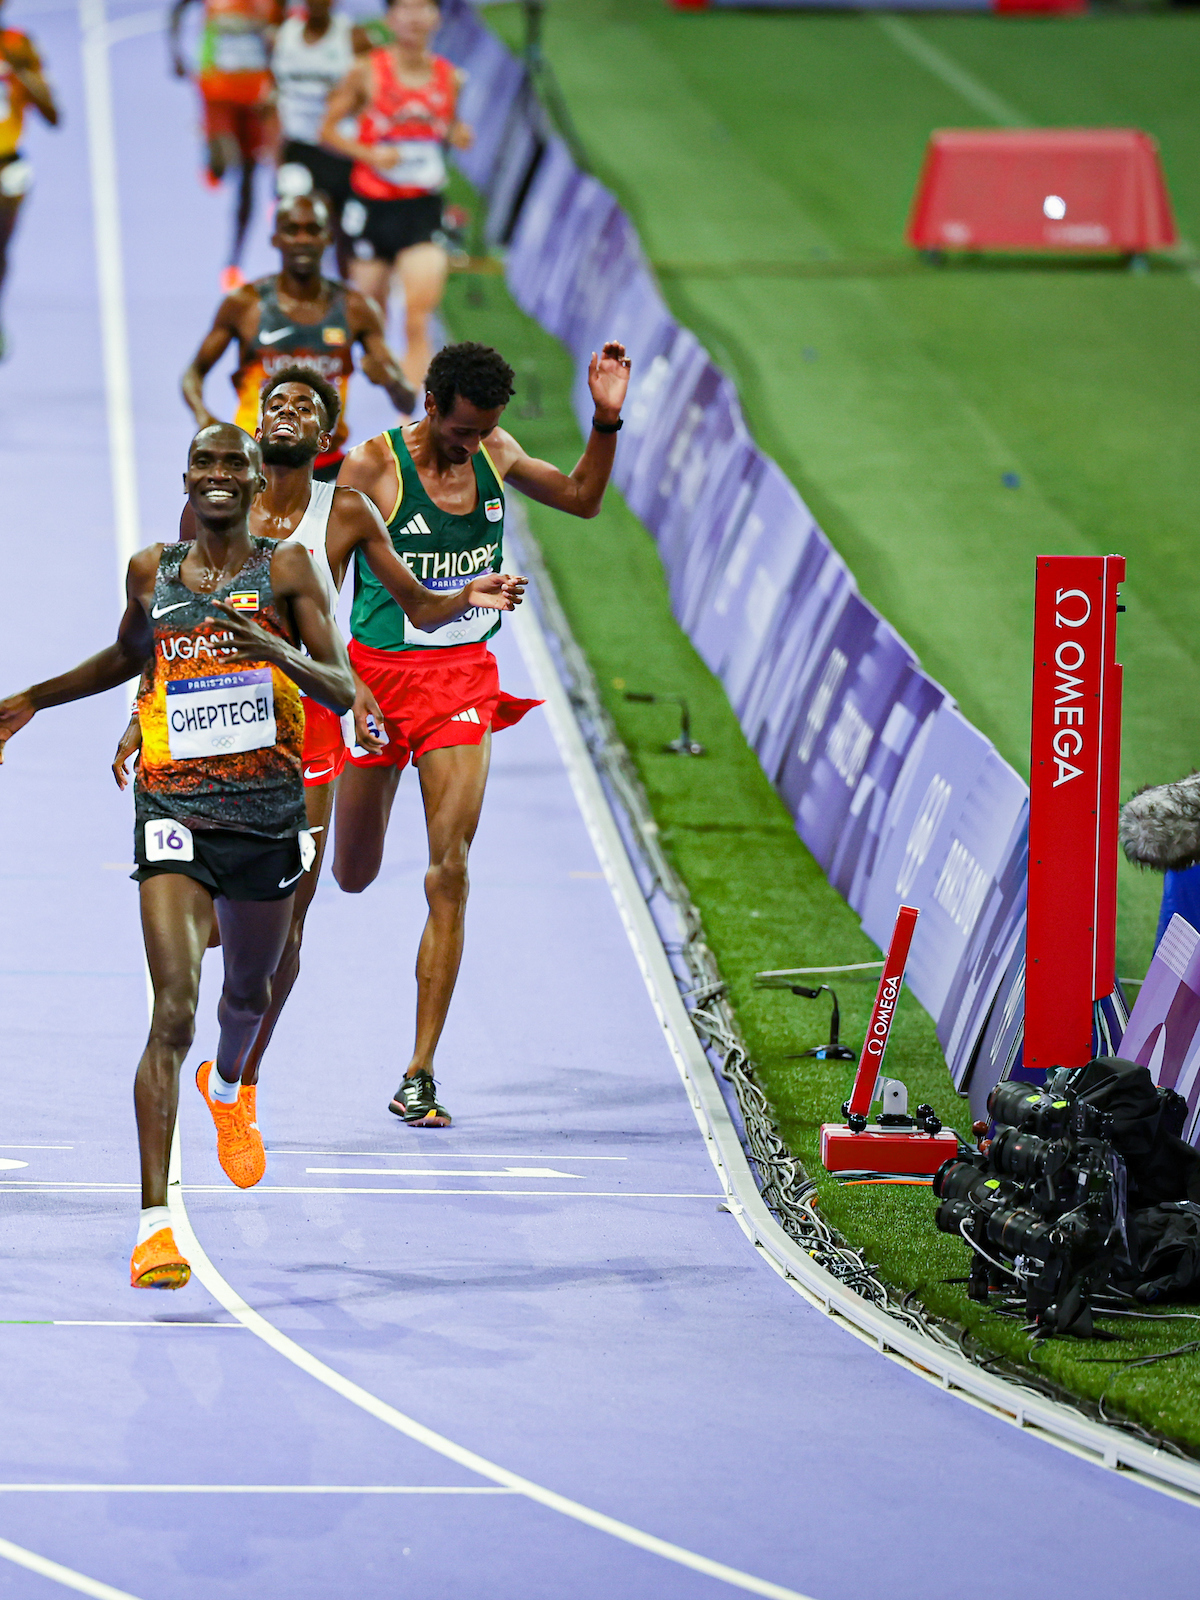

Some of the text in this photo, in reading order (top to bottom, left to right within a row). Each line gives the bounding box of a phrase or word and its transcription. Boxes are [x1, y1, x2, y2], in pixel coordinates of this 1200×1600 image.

[432, 579, 457, 588] PARIS
[161, 632, 239, 661] UGAN
[188, 676, 245, 690] PARIS 2024
[171, 697, 269, 733] CHEPTEGEI
[1052, 640, 1086, 788] OMEGA
[153, 829, 184, 850] 16
[873, 975, 901, 1036] OMEGA
